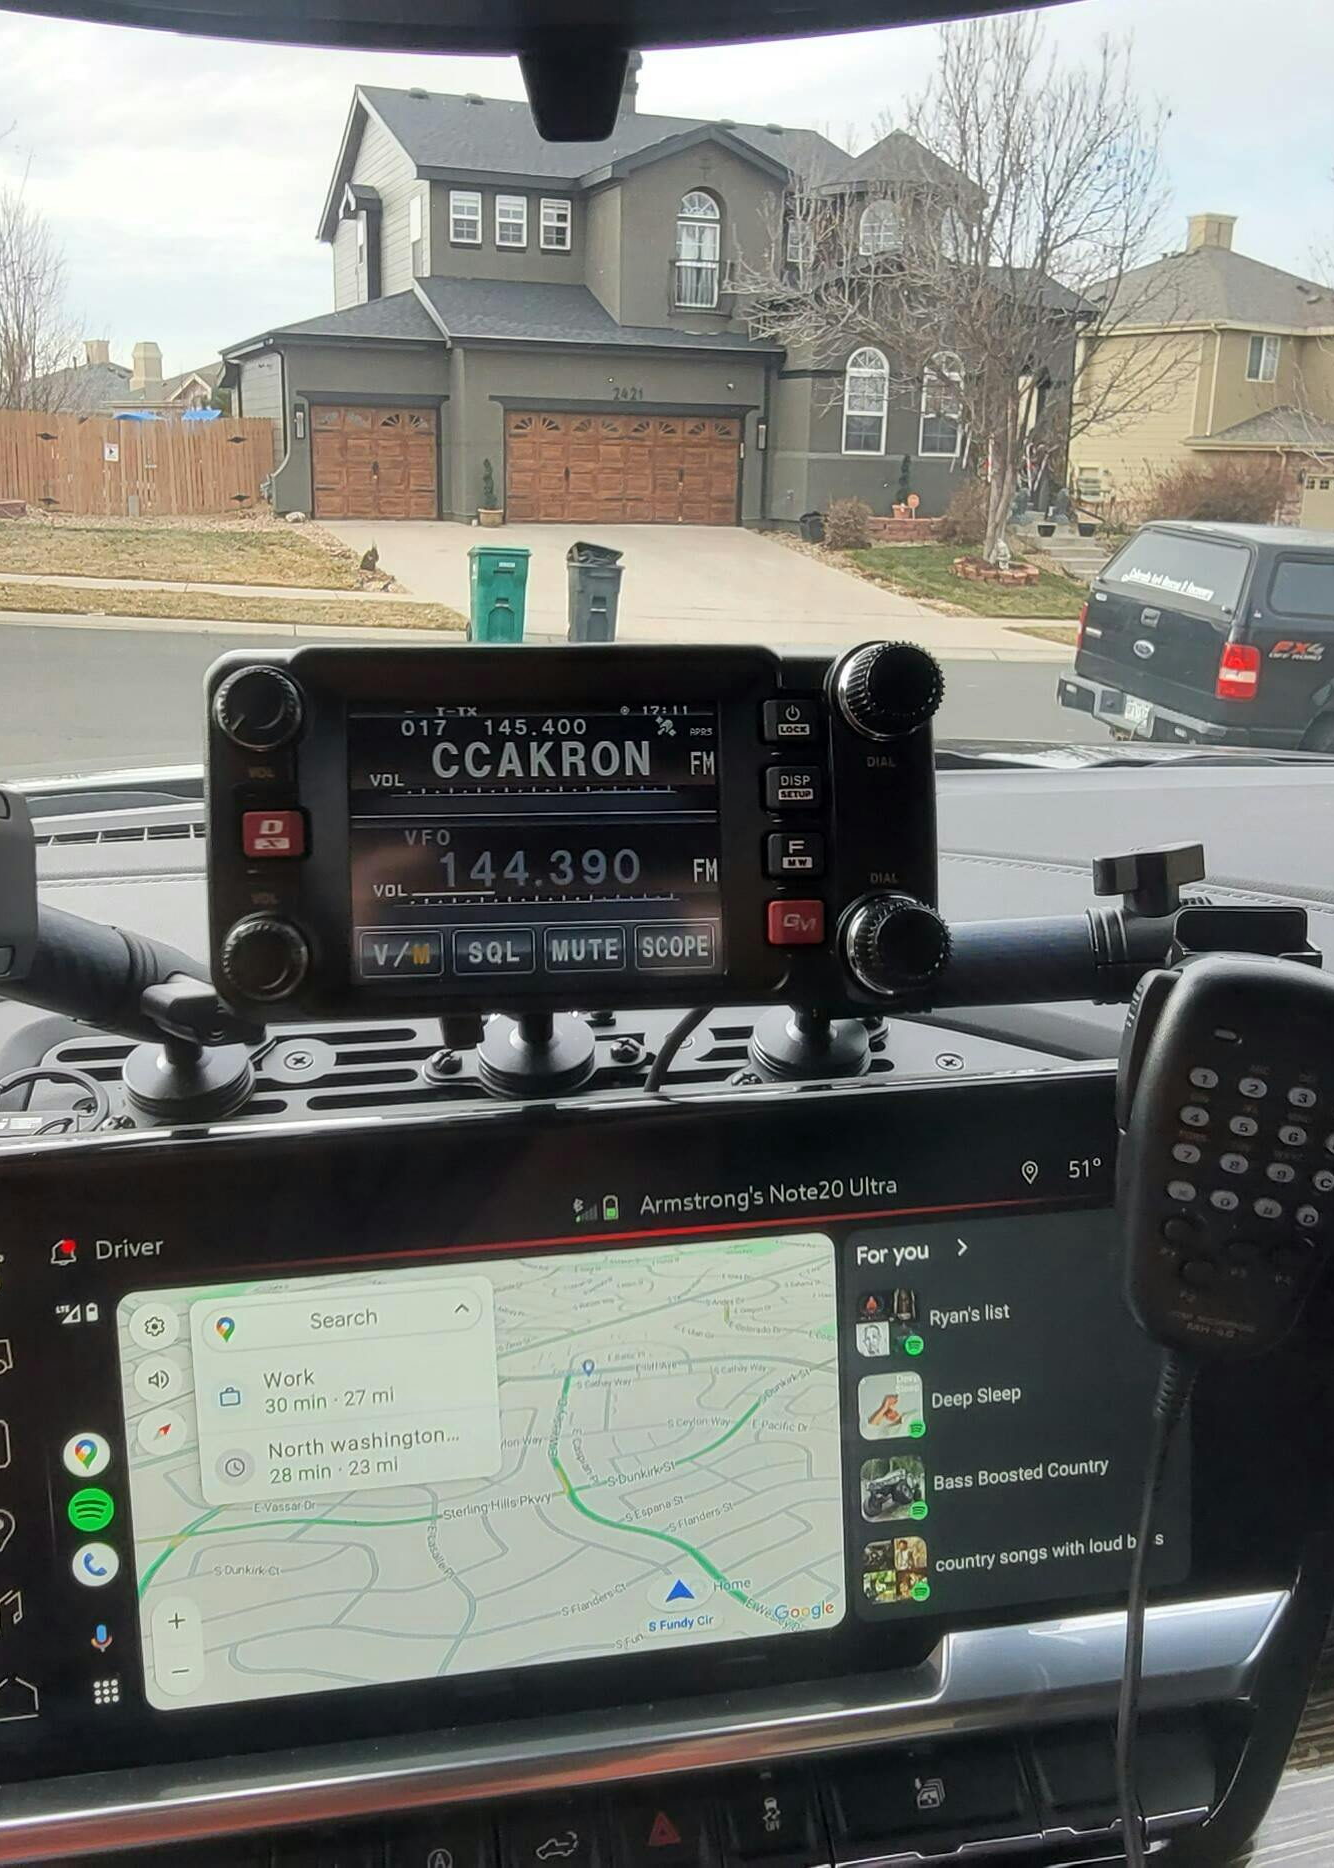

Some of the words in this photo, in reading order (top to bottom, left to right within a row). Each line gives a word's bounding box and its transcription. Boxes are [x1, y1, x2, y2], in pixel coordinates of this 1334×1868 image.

[1272, 640, 1325, 654] FX4
[401, 720, 448, 736] 017
[484, 719, 587, 736] 145.400
[780, 725, 808, 734] LOCK
[432, 740, 651, 778] CCAKRON
[690, 751, 715, 776] FM
[867, 756, 896, 768] DIAL
[369, 774, 405, 787] VOL
[780, 775, 811, 787] DISP
[780, 790, 813, 799] SETUP
[405, 830, 451, 847] VFO
[440, 849, 641, 887] 144.390
[693, 858, 718, 883] FM
[870, 872, 898, 884] DIAL
[373, 884, 408, 898] VOL
[373, 944, 431, 968] V/M
[468, 940, 520, 966] SQL
[551, 938, 618, 962] MUTE
[642, 935, 709, 959] SCOPE
[1069, 1157, 1101, 1178] 51°
[640, 1186, 764, 1215] Armstrong's
[770, 1179, 844, 1204] Note20
[850, 1176, 898, 1197] Ultra
[96, 1239, 164, 1260] Driver
[856, 1245, 888, 1266] For
[893, 1245, 929, 1267] you
[310, 1308, 378, 1330] Search
[930, 1306, 980, 1328] Ryan's
[985, 1303, 1010, 1321] list
[263, 1368, 315, 1389] Work
[266, 1397, 288, 1414] 30
[294, 1394, 327, 1412] min
[344, 1389, 366, 1407] 27
[372, 1386, 394, 1404] mi
[932, 1391, 973, 1409] Deep
[977, 1386, 1022, 1403] Sleep
[676, 1418, 708, 1430] Ceylon
[711, 1418, 731, 1428] Way
[761, 1419, 795, 1432] Pacific
[798, 1424, 808, 1432] Dr
[269, 1438, 324, 1460] North
[523, 1436, 543, 1447] Way
[270, 1467, 292, 1485] 28
[298, 1464, 332, 1481] min
[348, 1459, 371, 1476] 23
[377, 1456, 398, 1473] mi
[607, 1476, 615, 1487] S
[618, 1465, 661, 1484] Dunkirk
[663, 1461, 676, 1472] St
[934, 1474, 973, 1491] Bass
[978, 1463, 1043, 1486] Boosted
[1047, 1458, 1109, 1479] Country
[265, 1501, 301, 1512] Vassar
[303, 1501, 316, 1511] Dr
[443, 1504, 489, 1521] Sterling
[491, 1497, 517, 1511] Hills
[520, 1492, 552, 1506] Pkwy
[634, 1502, 672, 1520] Espana
[674, 1496, 684, 1507] St
[678, 1508, 720, 1529] Flanders
[723, 1503, 734, 1514] St
[935, 1553, 996, 1572] country
[999, 1547, 1048, 1566] songs
[1053, 1539, 1085, 1558] with
[1089, 1535, 1123, 1553] loud
[1127, 1533, 1165, 1549] bs
[224, 1566, 266, 1575] Dunkirk
[268, 1567, 280, 1576] Ct
[713, 1578, 751, 1591] Home
[570, 1590, 615, 1613] Flanders
[615, 1583, 627, 1595] Ct
[775, 1601, 834, 1622] Google
[648, 1622, 656, 1632] S
[660, 1618, 694, 1632] Fundy
[697, 1615, 714, 1626] Cir
